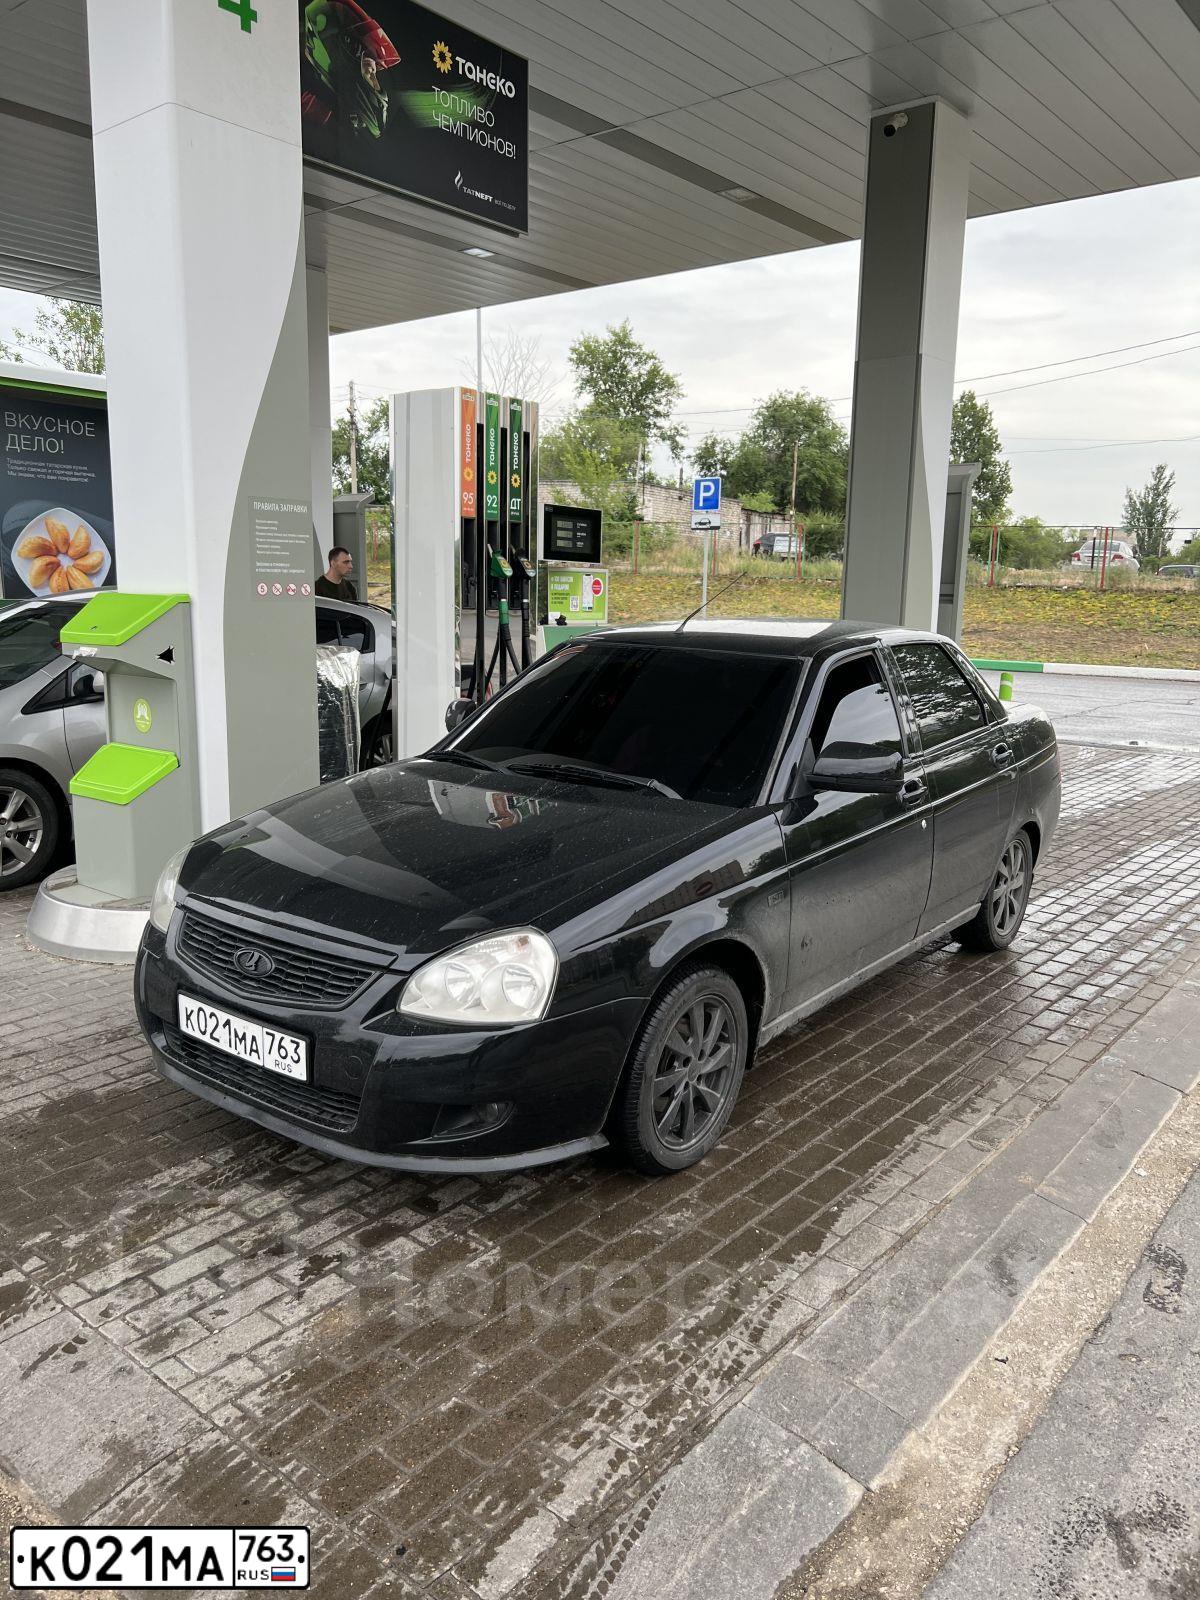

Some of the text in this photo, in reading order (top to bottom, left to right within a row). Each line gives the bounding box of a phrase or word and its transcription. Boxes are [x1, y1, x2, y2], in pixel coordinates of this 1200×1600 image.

[431, 85, 495, 127] ТОПЛИВО
[432, 109, 516, 160] ЧЕМПИОНОВ!
[462, 186, 494, 202] TATNEFT
[4, 411, 96, 437] ВКУСНОЕ
[6, 433, 64, 454] ДЕЛО!
[462, 491, 474, 505] 95
[486, 494, 498, 508] 92
[699, 481, 715, 507] P
[253, 501, 308, 513] ПРАВИЛА ЗАПРАВКИ
[509, 497, 521, 510] ДТ
[185, 1006, 301, 1064] К021МА 763
[274, 1059, 293, 1073] RUS
